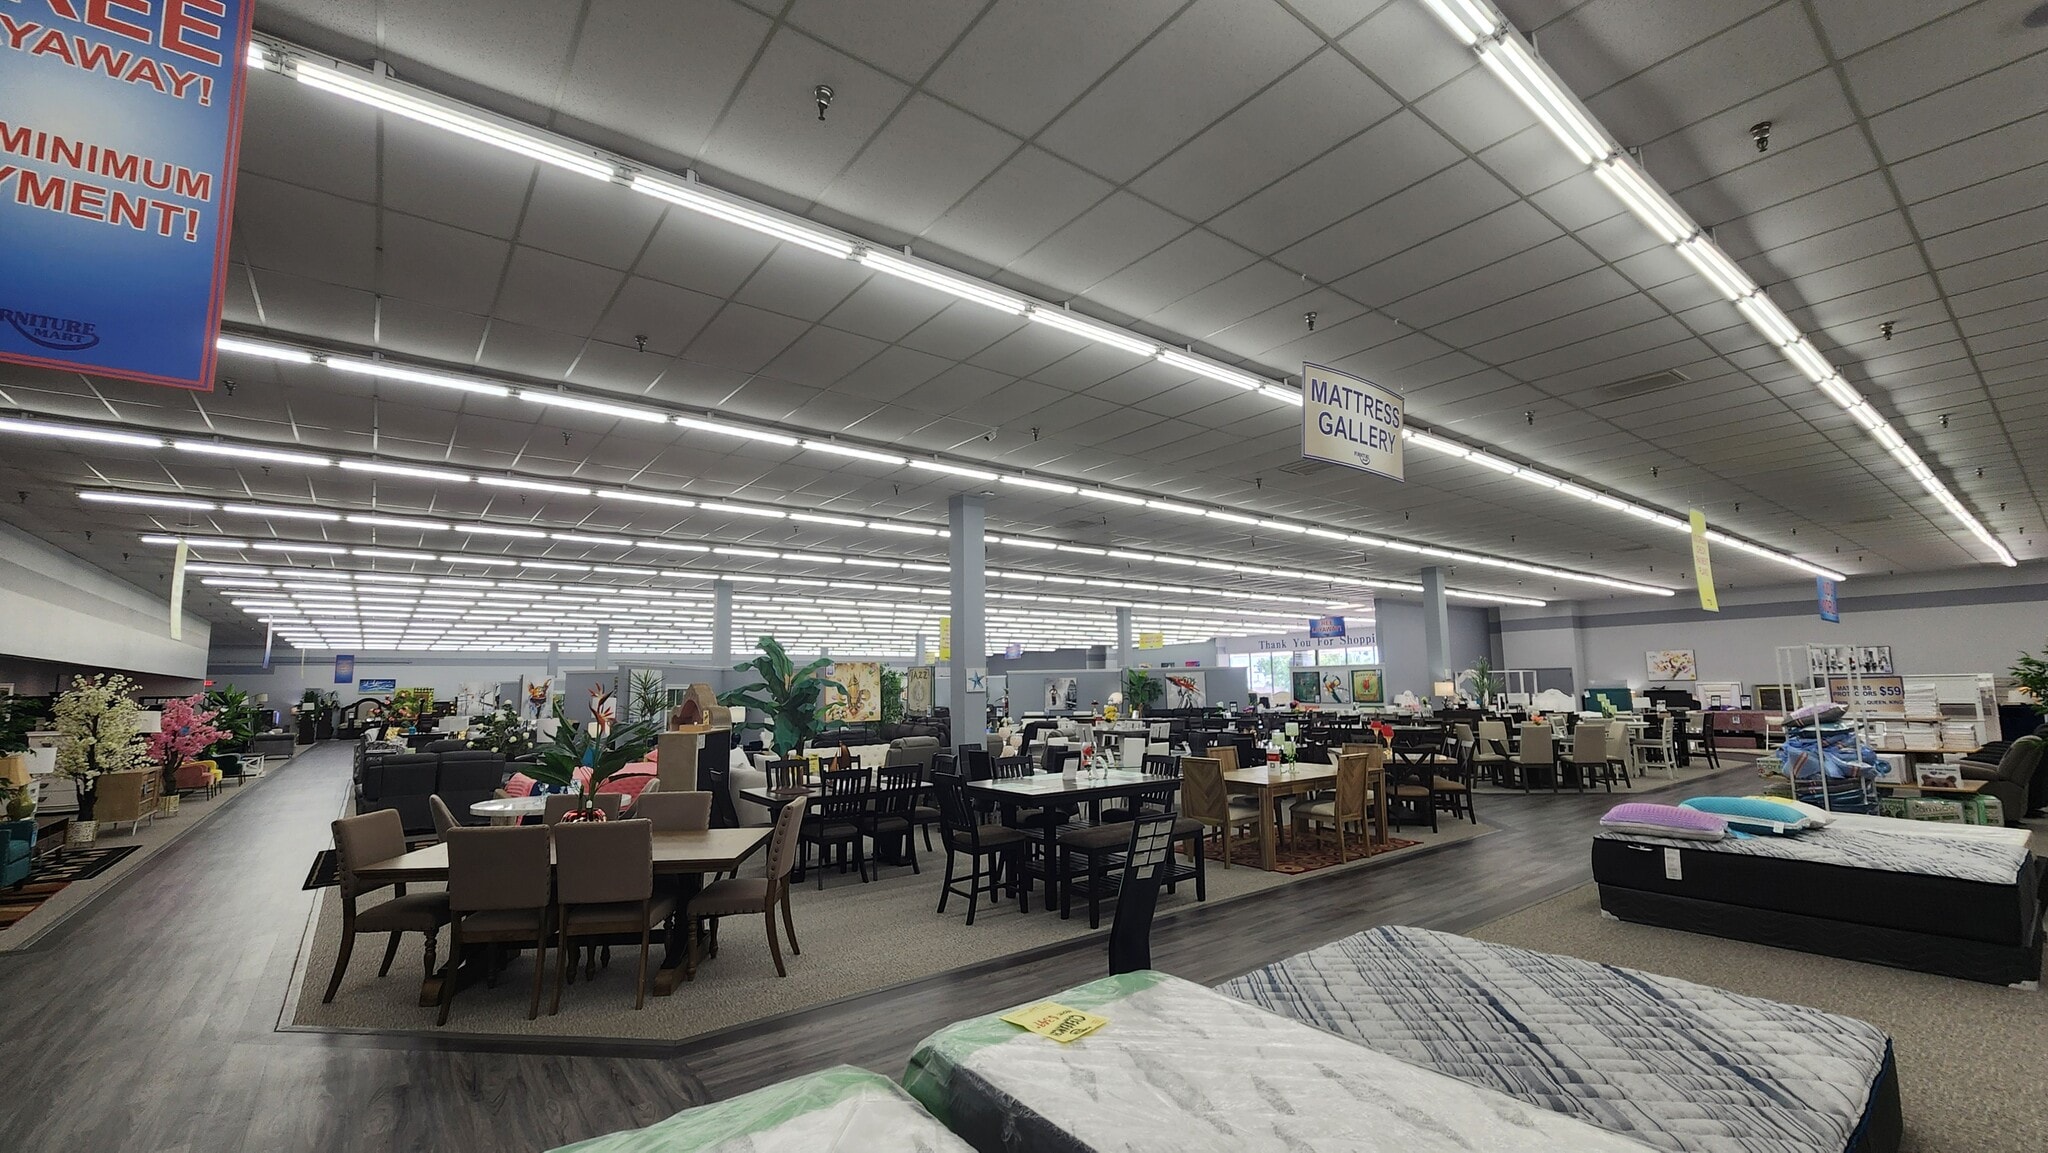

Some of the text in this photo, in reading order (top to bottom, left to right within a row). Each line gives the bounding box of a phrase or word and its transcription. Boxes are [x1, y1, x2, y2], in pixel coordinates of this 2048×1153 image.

[47, 0, 225, 67] EE
[0, 121, 212, 202] MINIMUM
[34, 328, 84, 343] MART
[1311, 378, 1400, 429] MATTRESS
[1318, 411, 1396, 454] GALLERY
[1258, 633, 1375, 650] Thank You For Shoppi
[910, 671, 928, 682] JAZZ
[1879, 685, 1901, 697] $59
